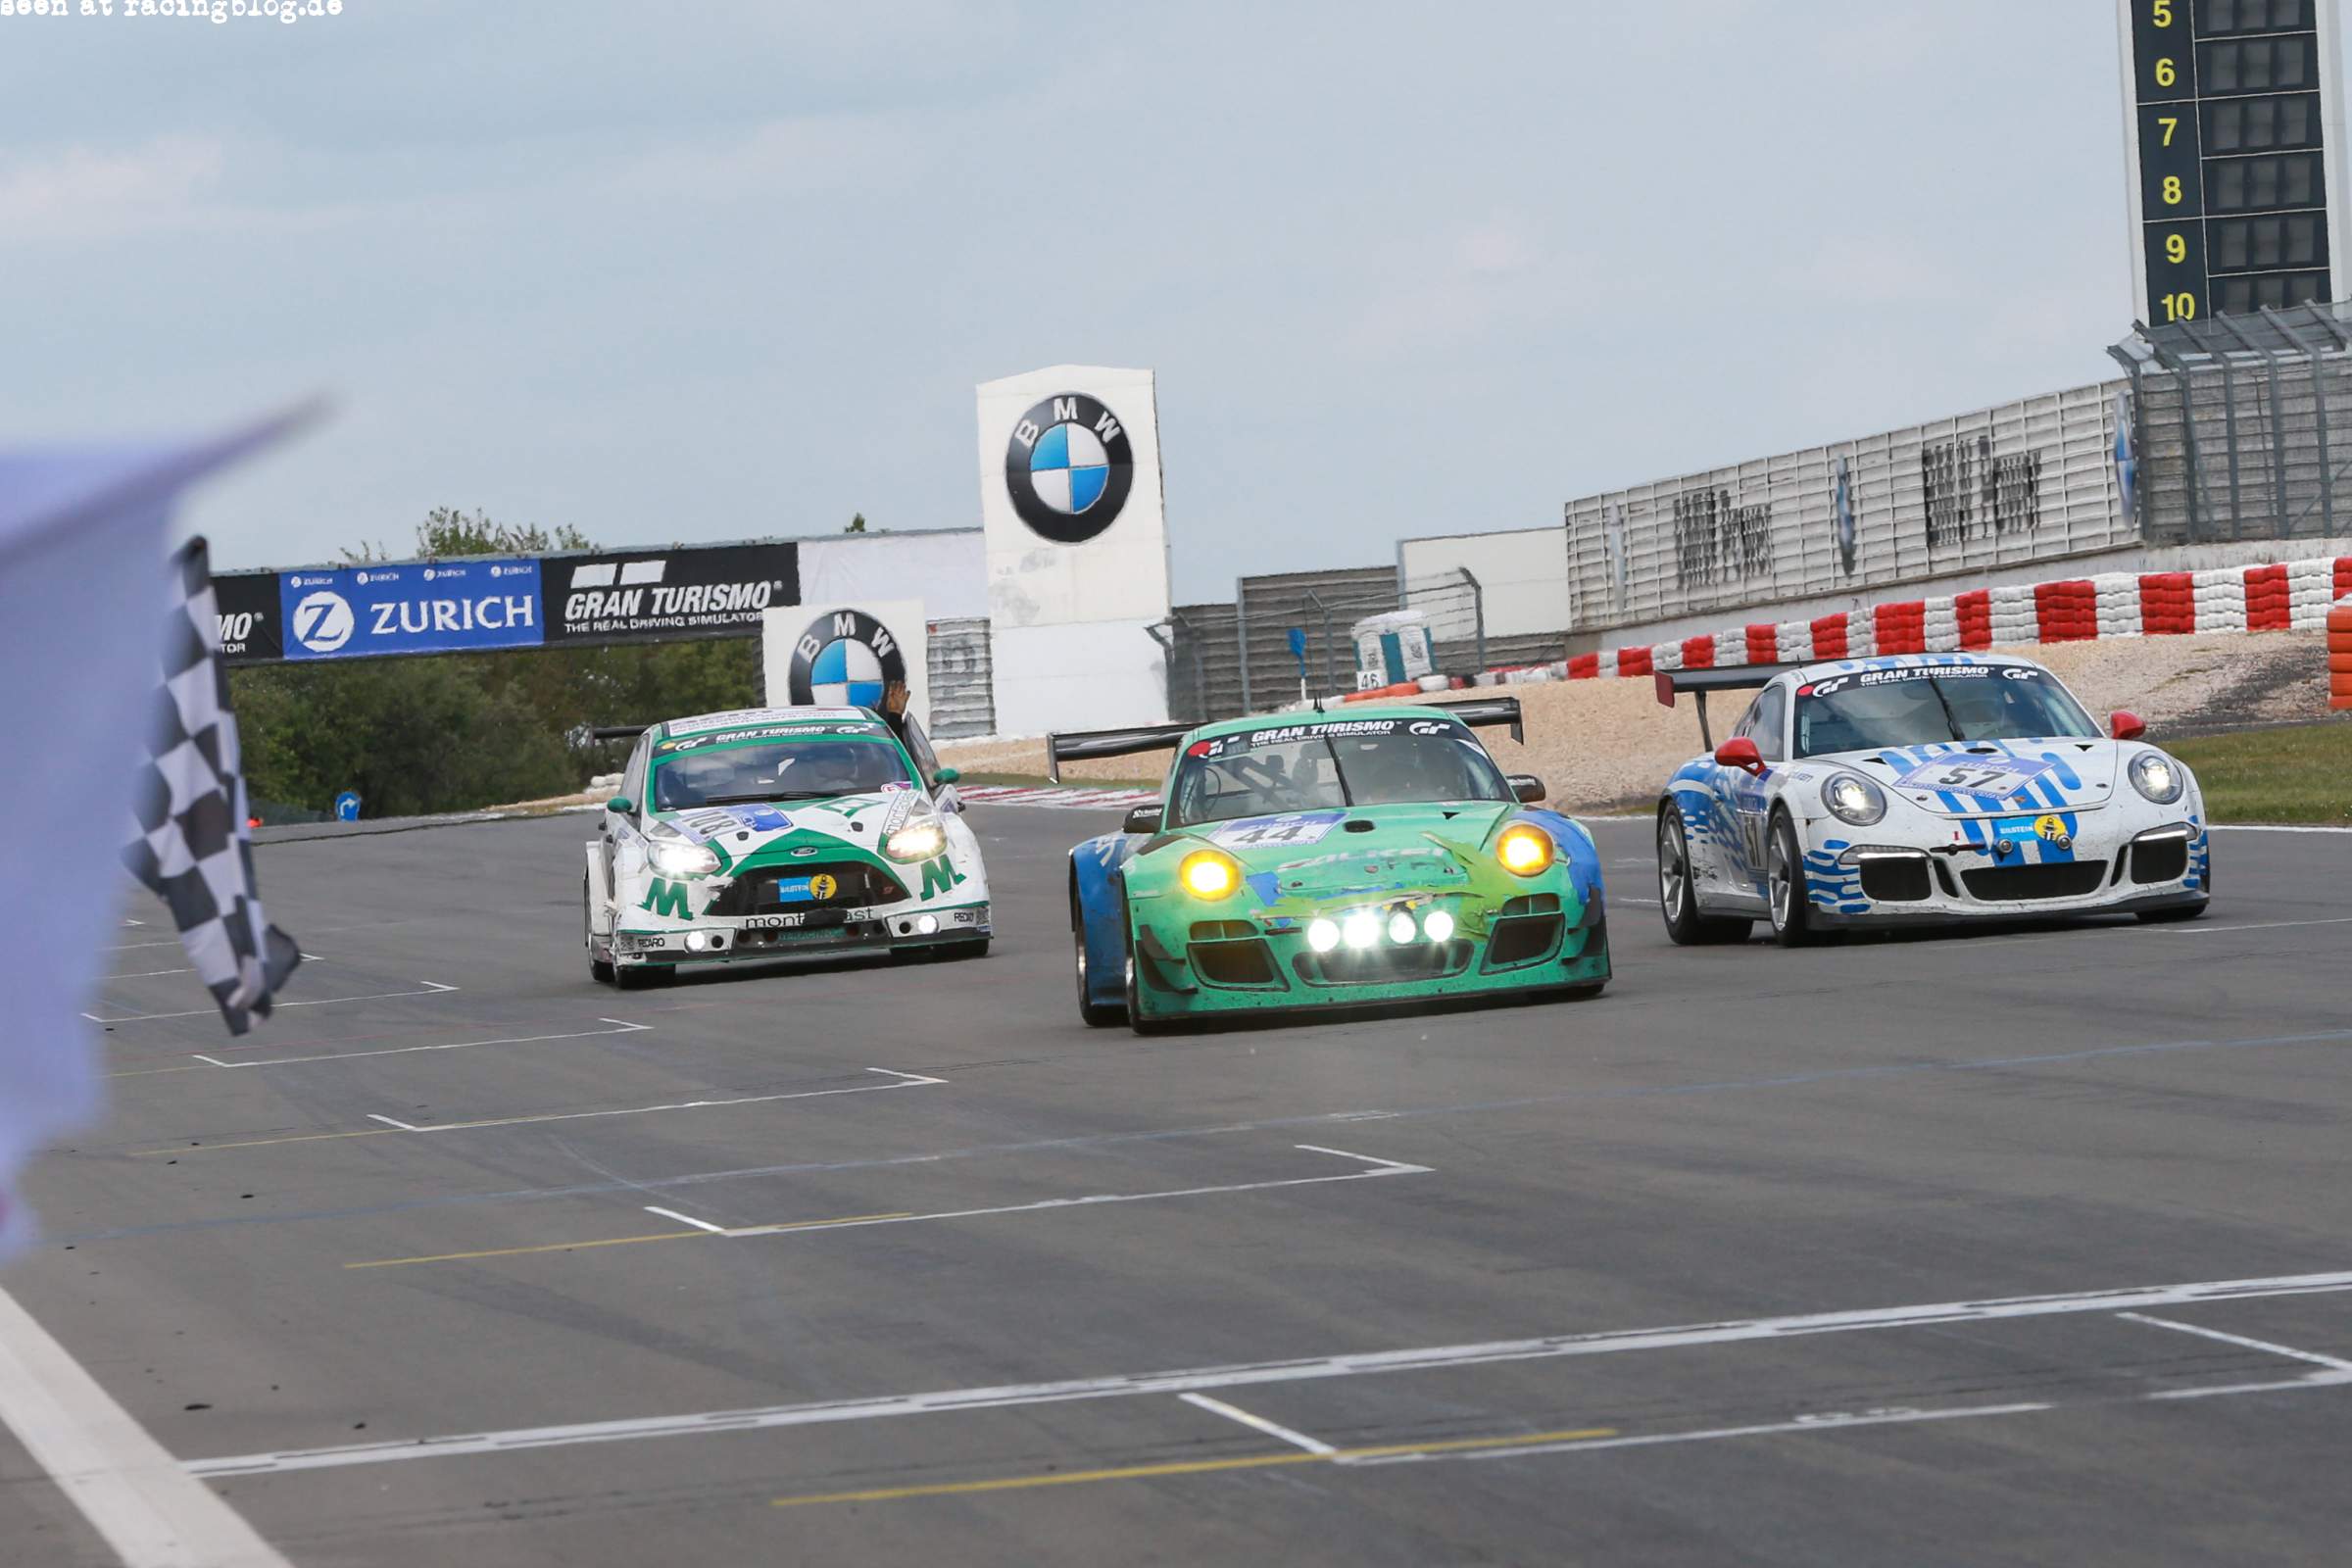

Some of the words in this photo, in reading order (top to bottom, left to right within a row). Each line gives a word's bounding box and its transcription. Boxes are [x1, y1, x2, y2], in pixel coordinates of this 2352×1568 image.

[2152, 0, 2173, 27] 5
[2155, 58, 2176, 87] 6
[2158, 118, 2178, 146] 7
[2162, 175, 2182, 205] 8
[2165, 233, 2186, 264] 9
[2161, 292, 2195, 321] 10
[1014, 396, 1122, 449] BMW
[564, 588, 645, 621] GRAN
[651, 580, 772, 615] TURISMO
[369, 595, 535, 635] ZURICH
[564, 621, 590, 634] THE
[593, 618, 627, 631] REAL
[629, 614, 686, 630] DRIVING
[797, 612, 896, 663] BMW
[1859, 668, 1909, 683] GRAN
[715, 730, 758, 742] GRAN
[762, 725, 826, 736] TURISMO
[1250, 726, 1306, 743] GRAN
[1938, 767, 2008, 788] 57
[1233, 826, 1305, 844] 44
